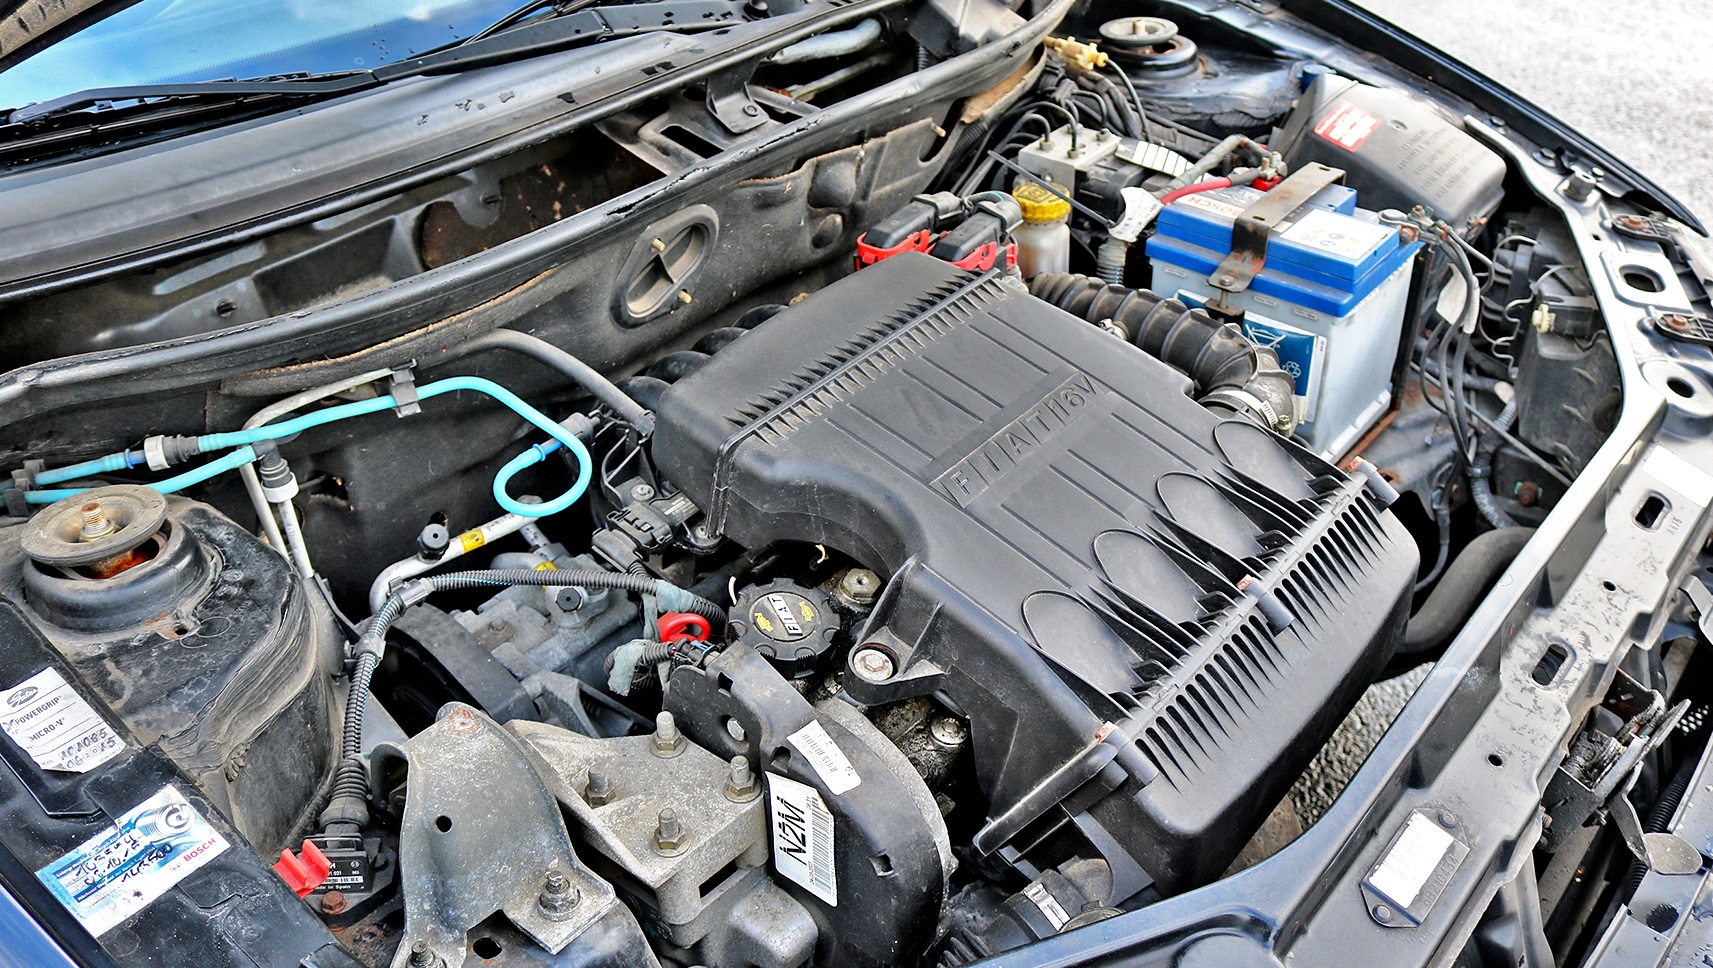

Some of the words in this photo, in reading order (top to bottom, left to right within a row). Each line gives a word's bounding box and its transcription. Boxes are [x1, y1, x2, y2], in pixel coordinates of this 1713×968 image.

[949, 408, 1051, 495] FIAT
[1051, 374, 1097, 416] 16V
[771, 597, 800, 632] FIAT
[15, 697, 60, 725] POWERGRIP
[30, 719, 63, 742] MICRO-V
[183, 837, 218, 862] BOSCH
